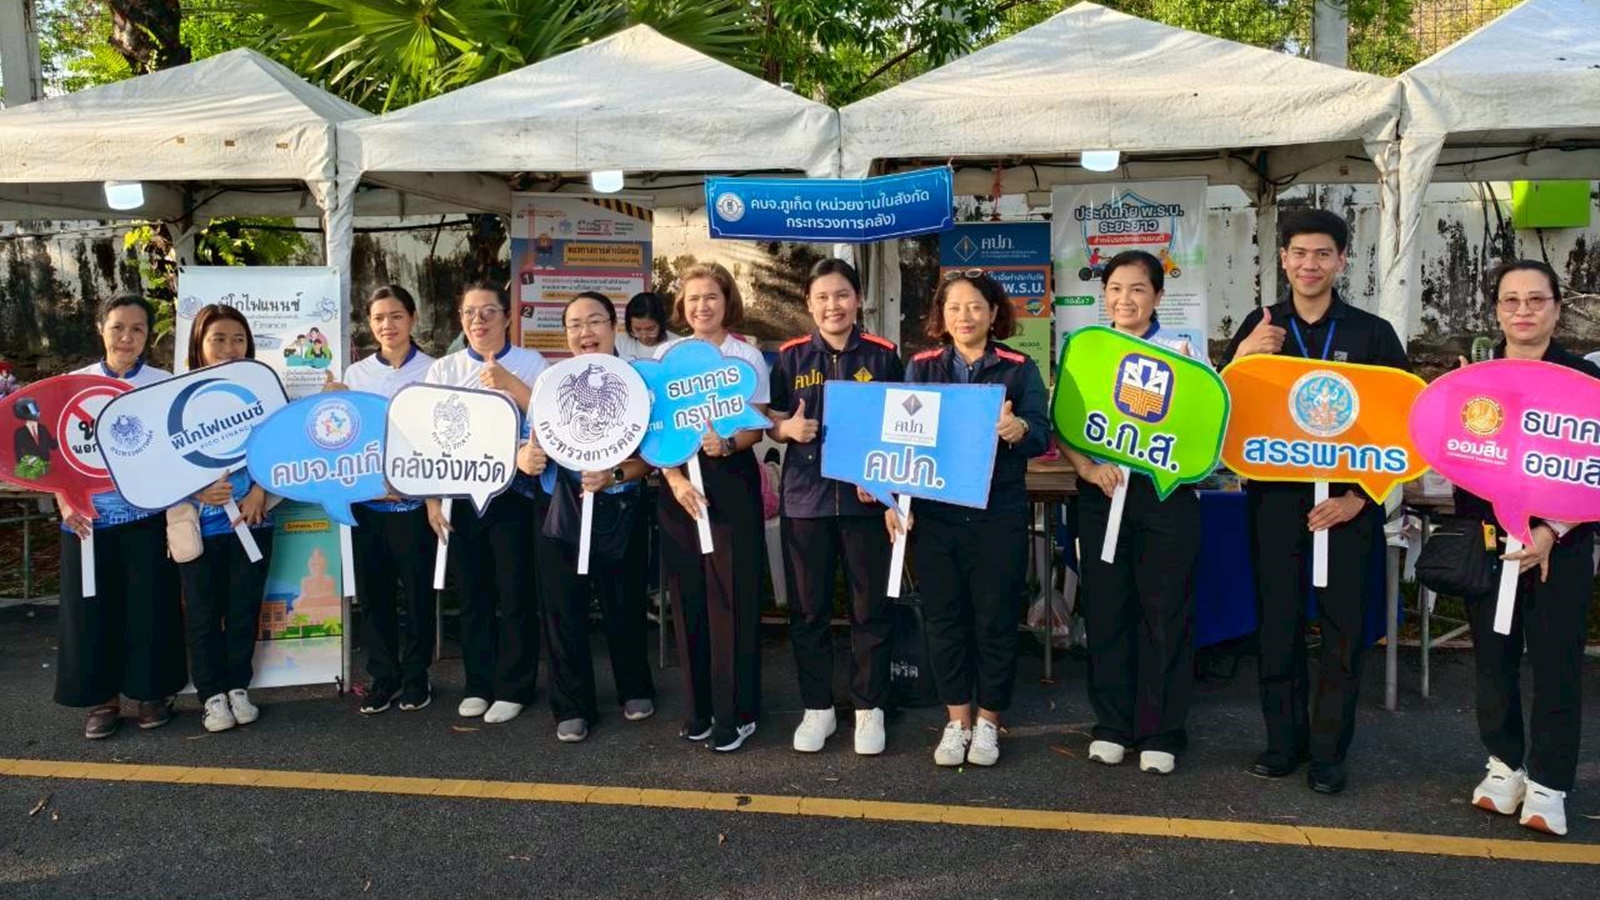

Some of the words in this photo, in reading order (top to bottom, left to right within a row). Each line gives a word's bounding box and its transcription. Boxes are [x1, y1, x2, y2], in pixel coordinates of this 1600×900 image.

[750, 195, 812, 214] คบจ.ภูเก็ต
[816, 189, 930, 212] (หน่วยงานในสังกัด
[1075, 204, 1138, 221] ประกันภัย
[1140, 204, 1184, 219] พ.ร.บ.
[786, 214, 896, 229] กระทรวงการคลัง)
[1099, 219, 1159, 234] ระยะยาว
[981, 234, 1015, 249] คปภ.
[668, 366, 741, 399] ธนาคาร
[170, 400, 265, 450] พิโกไฟแนนซ์
[674, 395, 744, 430] กรุงไทย
[1523, 411, 1600, 443] ธนาค
[221, 424, 253, 440] FINANC
[539, 420, 642, 461] กระทรวงการคลัง
[1085, 412, 1178, 472] ธ.ก.ส.
[272, 441, 382, 485] คบจ.ภูเก็
[1244, 438, 1407, 472] สรรพากร
[1447, 439, 1508, 460] ออมสิน
[391, 450, 506, 483] คลังจังหวัด
[865, 447, 944, 488] คปภ.
